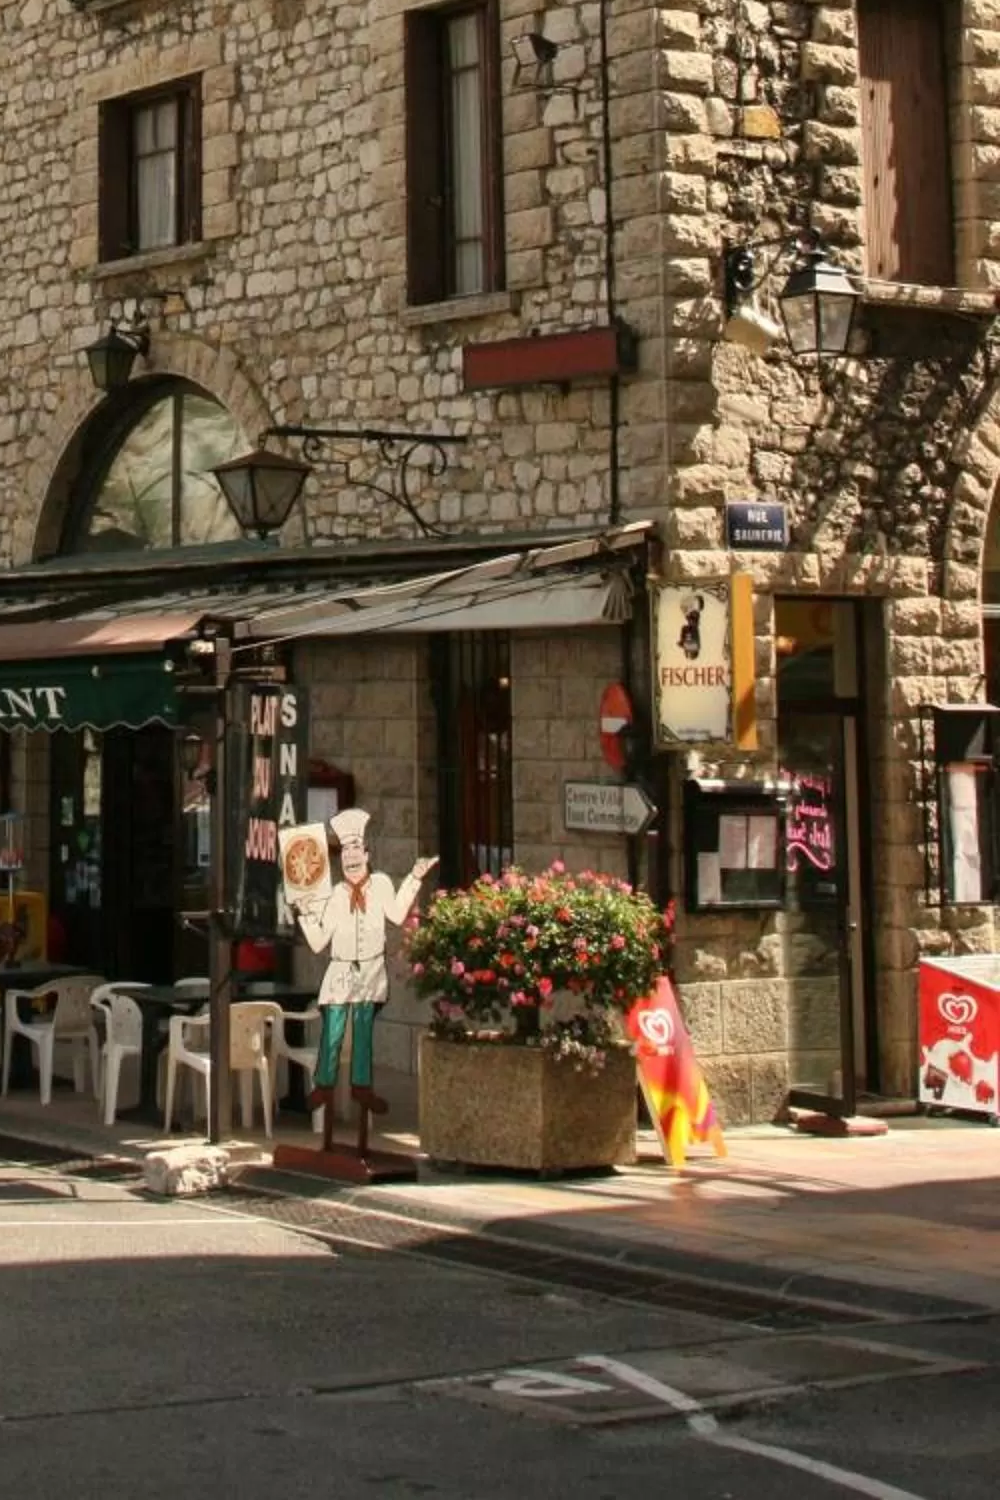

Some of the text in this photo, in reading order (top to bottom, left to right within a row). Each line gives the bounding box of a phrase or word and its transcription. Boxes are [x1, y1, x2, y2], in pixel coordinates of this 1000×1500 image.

[661, 666, 726, 687] FISCHER
[251, 695, 279, 736] PLAT
[277, 693, 298, 925] SNAK
[246, 818, 277, 862] JOUR
